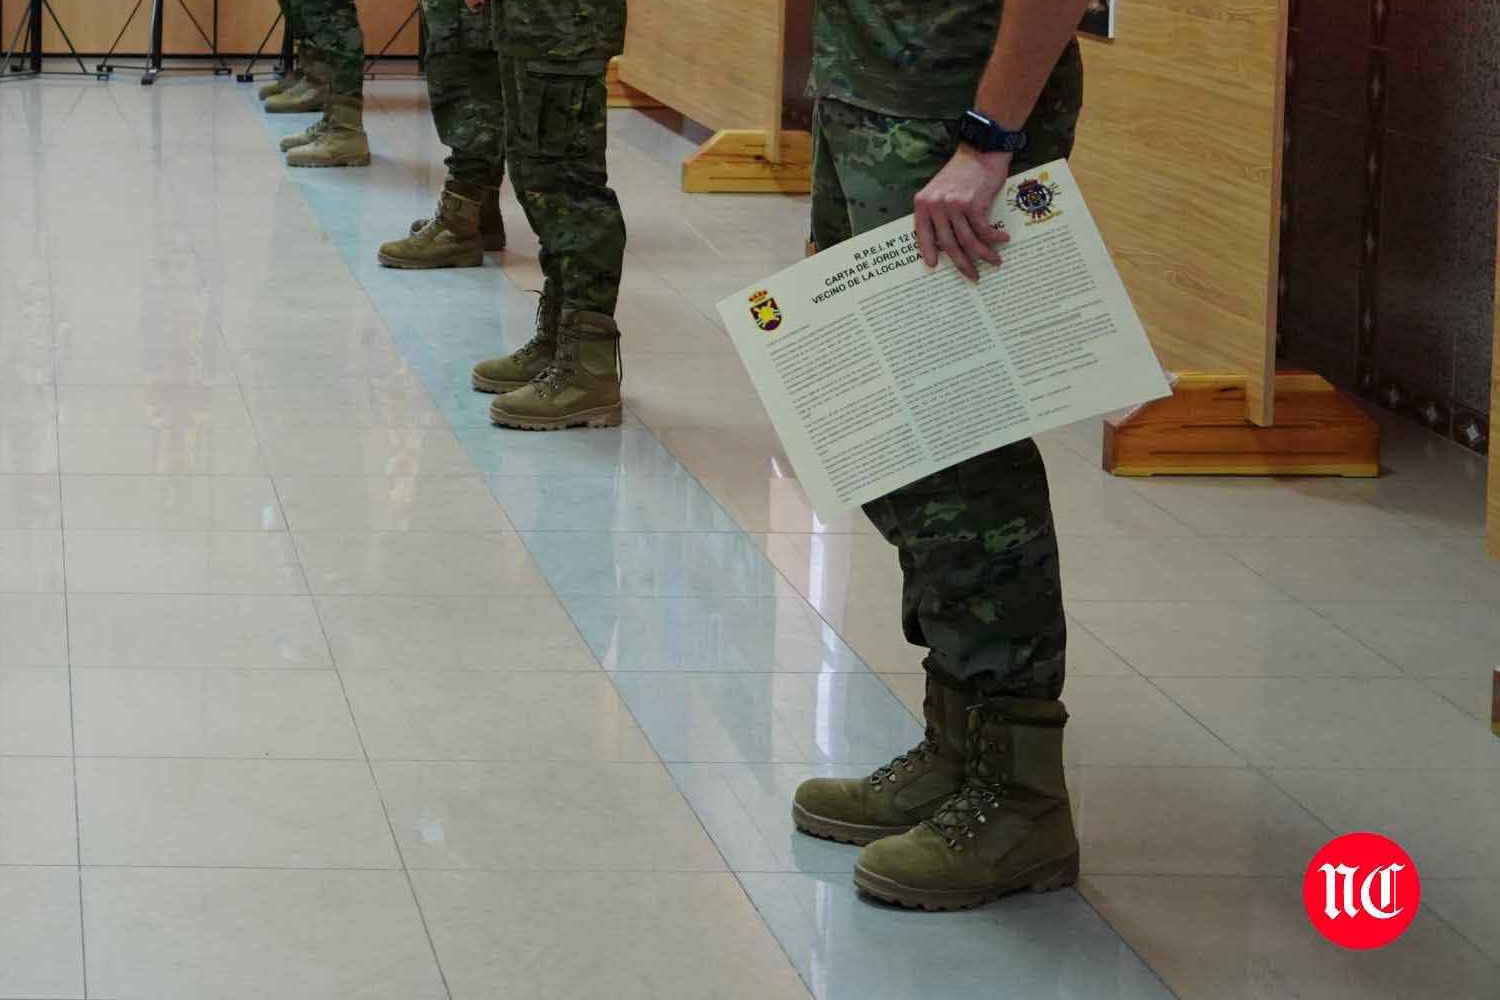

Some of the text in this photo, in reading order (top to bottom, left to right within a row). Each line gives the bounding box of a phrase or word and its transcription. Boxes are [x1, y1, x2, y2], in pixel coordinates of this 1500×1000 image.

[899, 233, 910, 244] 12
[812, 283, 846, 304] VECINO
[847, 276, 861, 289] DE
[861, 270, 876, 282] LA
[876, 253, 923, 276] LOCALIDA
[824, 267, 855, 287] CARTA
[856, 260, 870, 273] DE
[871, 248, 900, 266] JORDI
